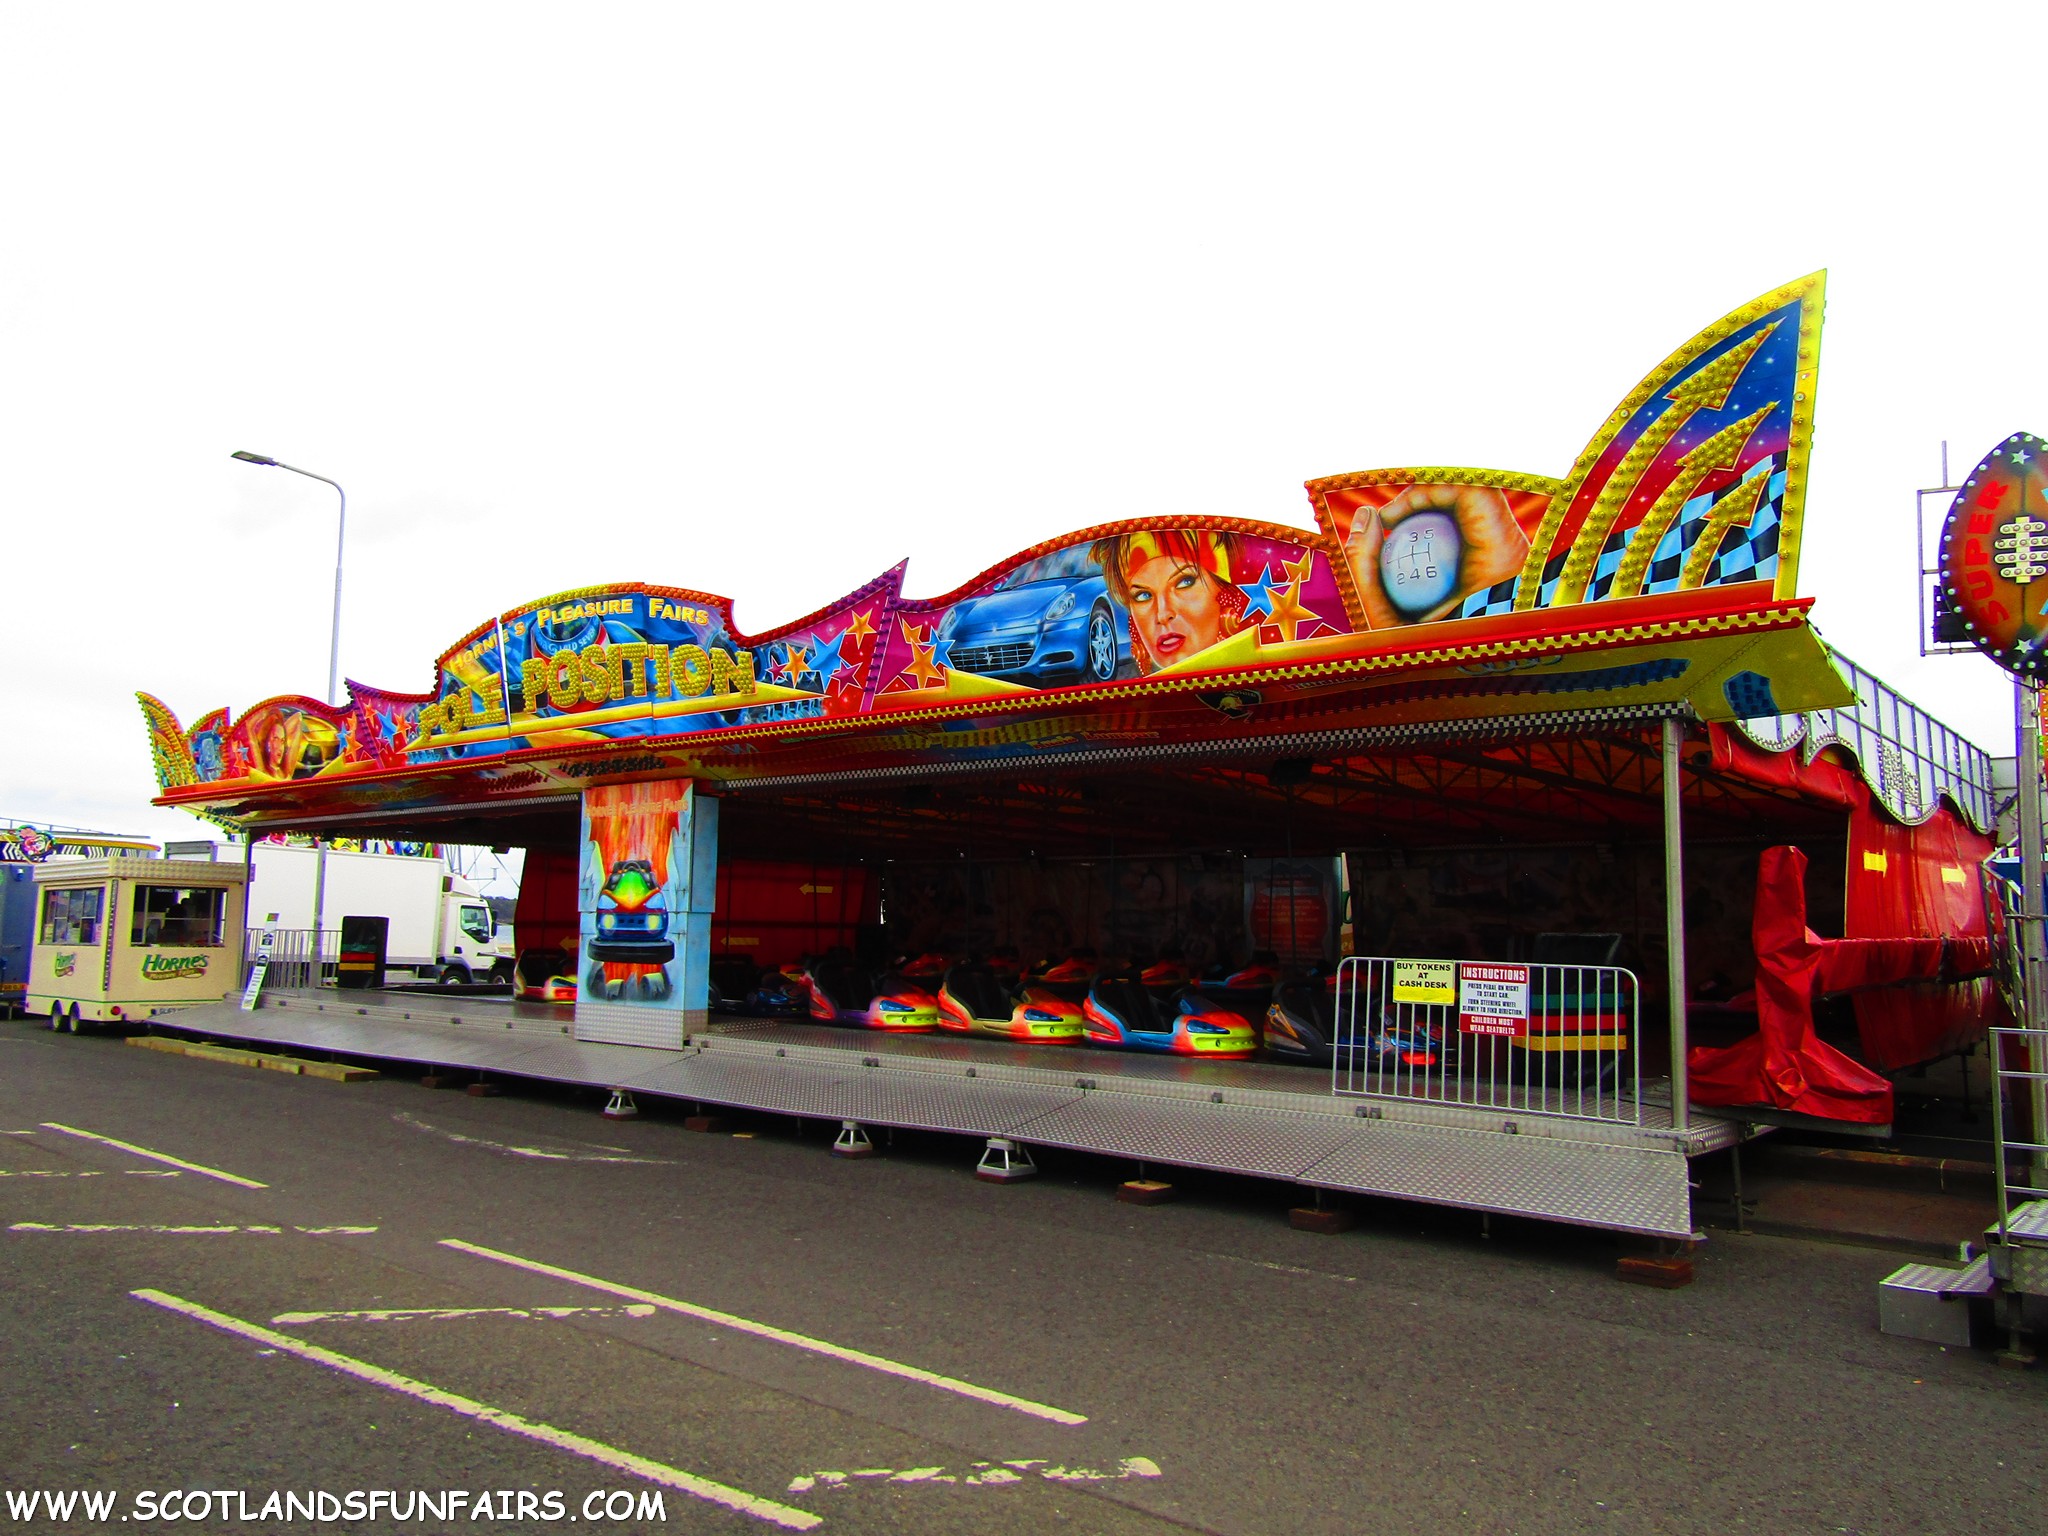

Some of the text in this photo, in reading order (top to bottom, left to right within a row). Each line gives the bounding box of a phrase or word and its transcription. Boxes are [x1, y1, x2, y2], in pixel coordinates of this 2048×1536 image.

[1409, 528, 1434, 543] 3 5
[1965, 480, 2010, 626] SUPER
[1396, 565, 1437, 585] 2 4 6
[536, 599, 633, 628] PLEASURE
[649, 597, 710, 626] FAIRS
[418, 642, 757, 742] POLE POSITION
[1416, 963, 1451, 971] TOKENS
[1462, 966, 1525, 981] INSTRUCTIONS
[1399, 980, 1448, 989] CASH DESK
[1470, 1024, 1485, 1032] WEAR
